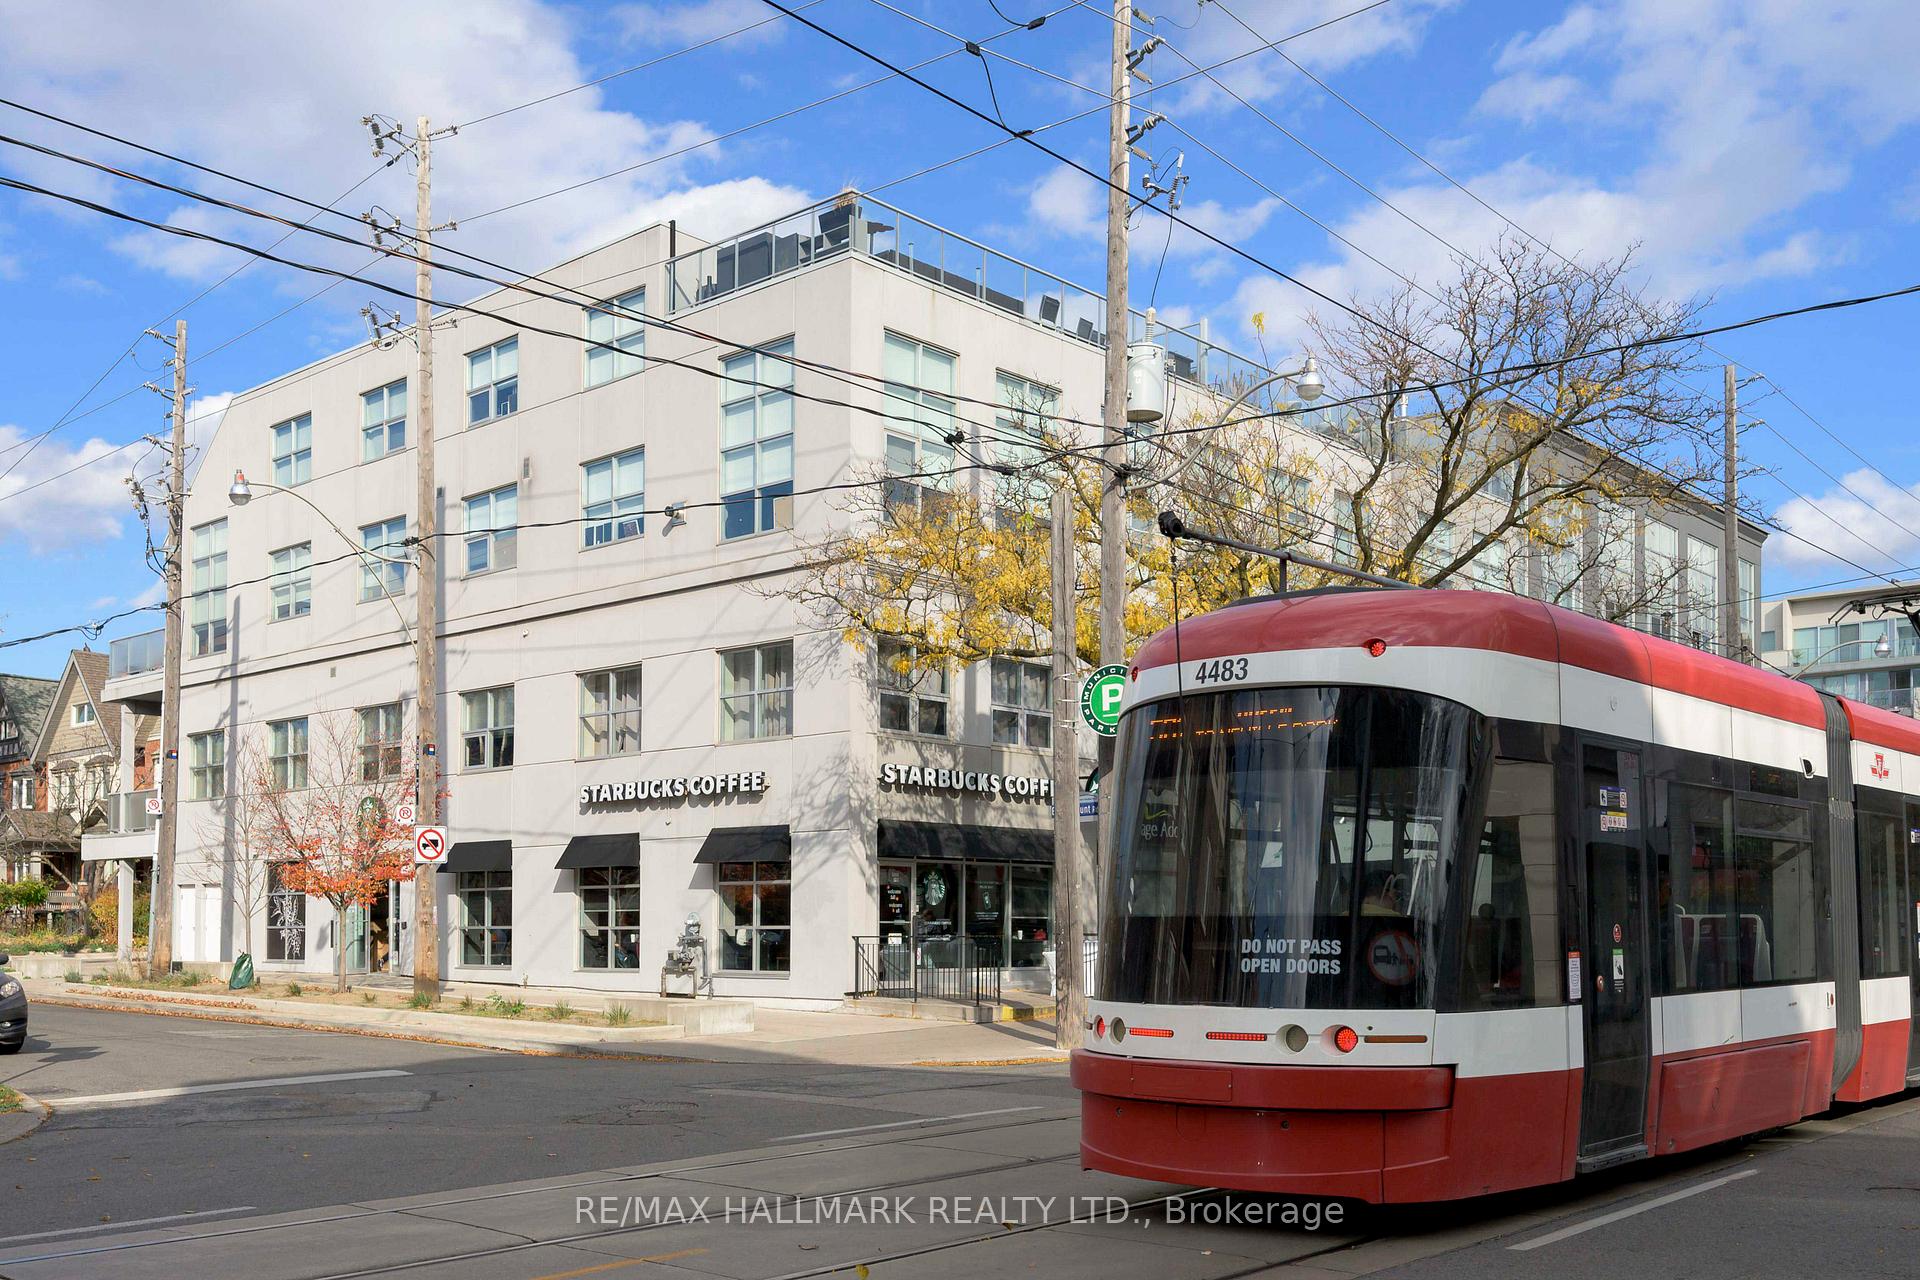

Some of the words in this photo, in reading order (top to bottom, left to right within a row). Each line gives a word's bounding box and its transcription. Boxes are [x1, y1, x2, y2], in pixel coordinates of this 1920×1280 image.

[1084, 667, 1124, 700] MUNICI
[1195, 658, 1249, 684] 4483
[1101, 683, 1124, 712] P
[1084, 708, 1116, 734] PARK
[579, 777, 686, 804] STARBUCKS
[688, 771, 765, 796] COFFEE
[879, 763, 1000, 793] STARBUCKS
[1004, 774, 1055, 797] COFF
[1241, 939, 1261, 954] DO
[1266, 939, 1296, 954] NOT
[1300, 939, 1342, 955] PASS
[1241, 958, 1281, 973] OPEN
[1286, 958, 1341, 975] DOORS
